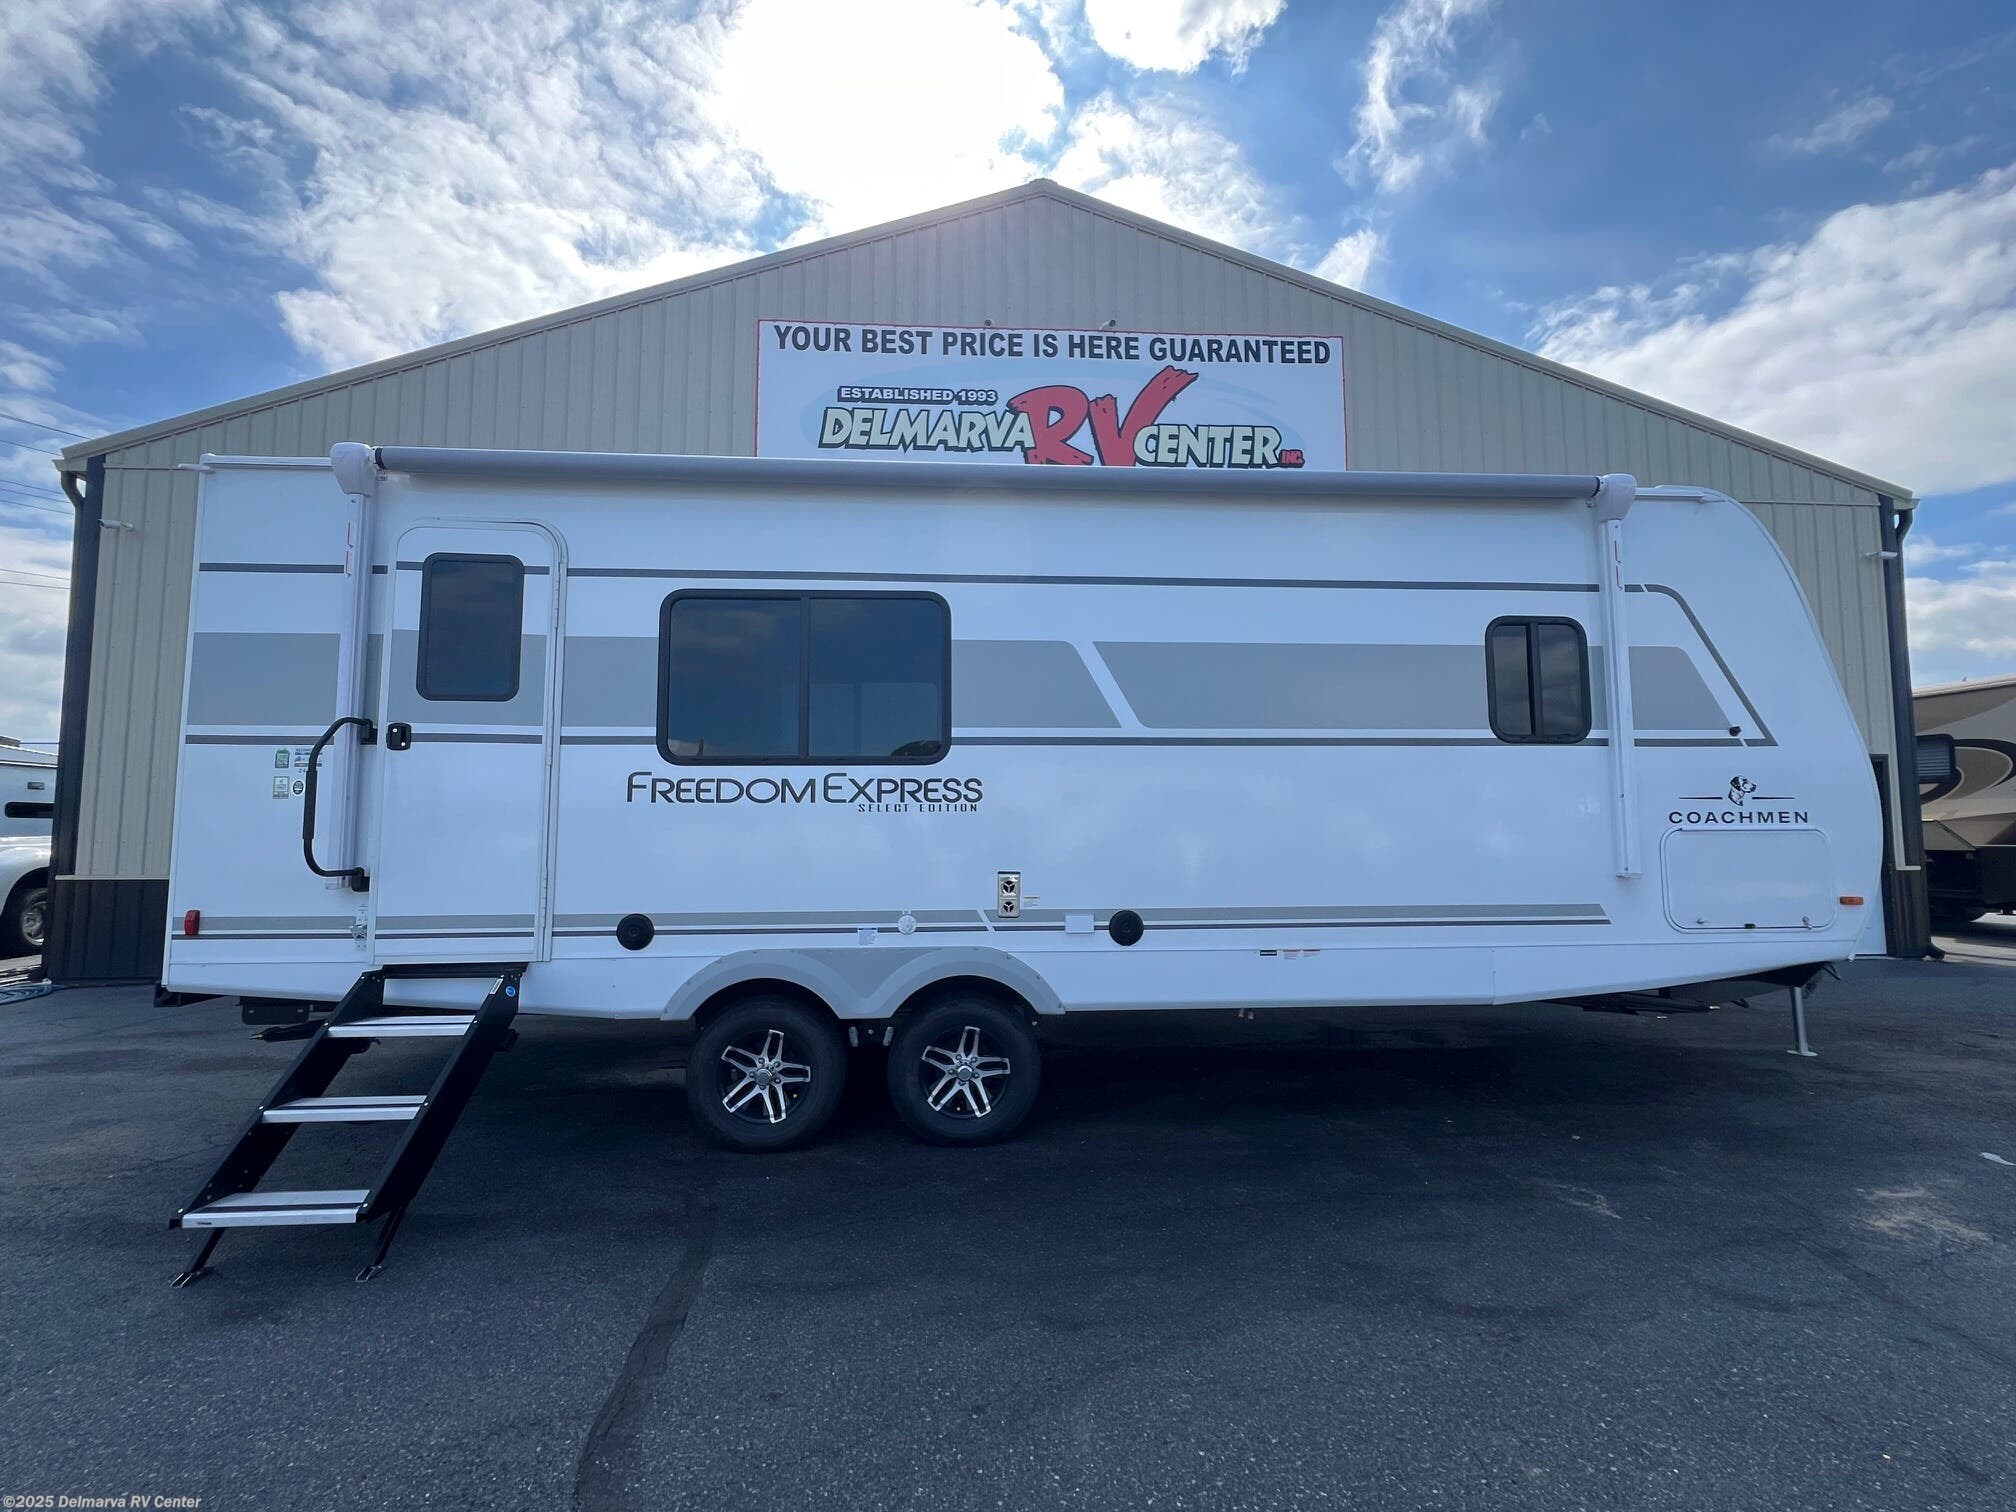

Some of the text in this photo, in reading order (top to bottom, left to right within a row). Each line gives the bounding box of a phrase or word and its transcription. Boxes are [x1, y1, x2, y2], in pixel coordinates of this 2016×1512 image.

[774, 325, 1331, 364] YOUR BEST PRICE IS HERE GUARANTEED
[838, 386, 998, 404] ESTABLISHED 1993
[818, 407, 1037, 452] DELMARVA
[1006, 365, 1199, 466] RV
[1133, 424, 1282, 467] CENTER
[626, 771, 984, 804] FREEDOM EXPRESS
[858, 803, 978, 813] SELECT EDITION
[1668, 811, 1809, 824] COACHMEN
